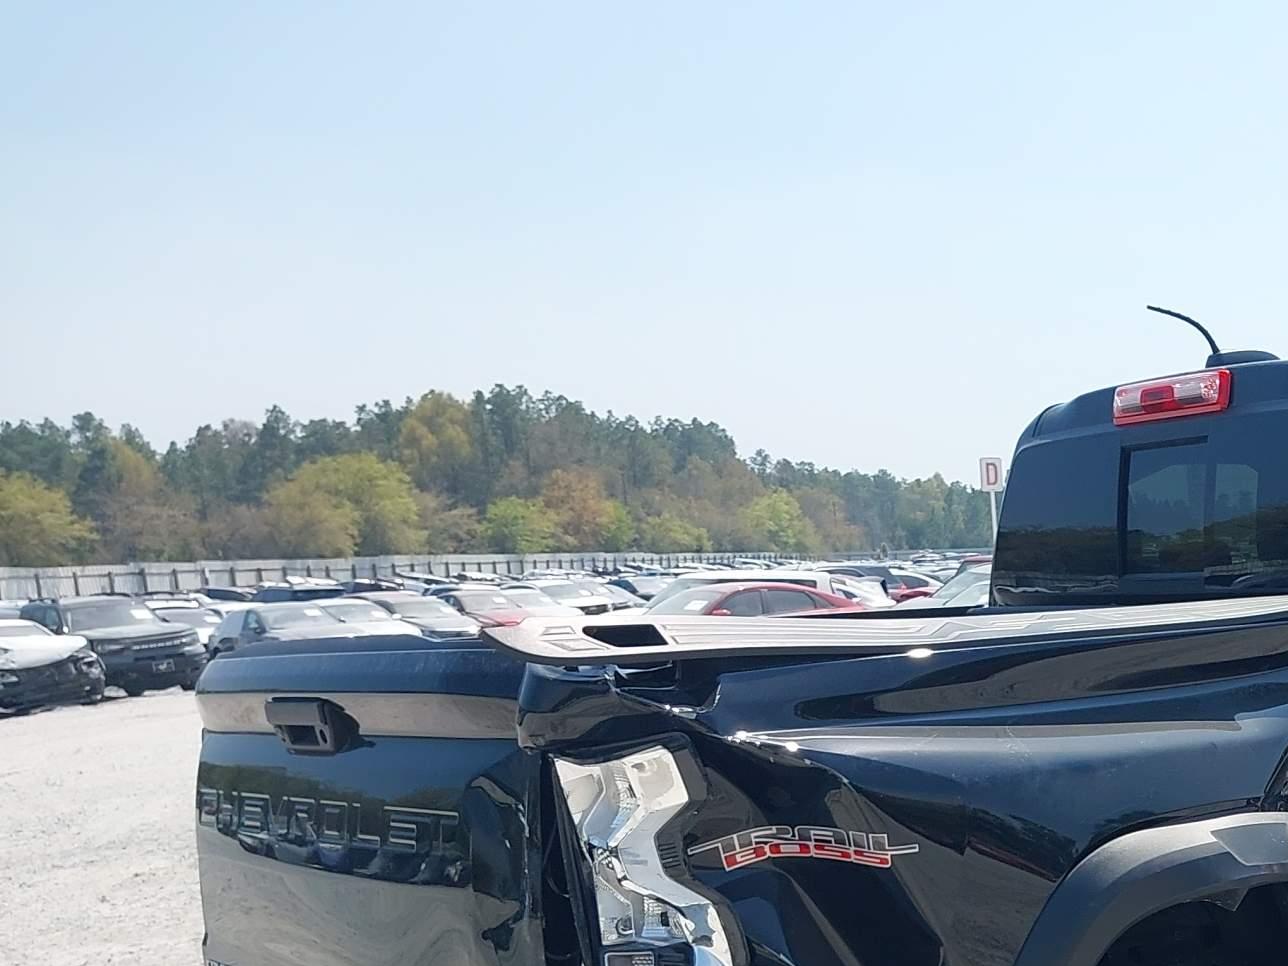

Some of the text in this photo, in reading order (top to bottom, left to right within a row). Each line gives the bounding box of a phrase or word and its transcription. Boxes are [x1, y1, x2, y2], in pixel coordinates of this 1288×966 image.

[986, 462, 998, 486] D
[688, 826, 919, 856] TRAIL
[722, 840, 891, 871] BOSS
